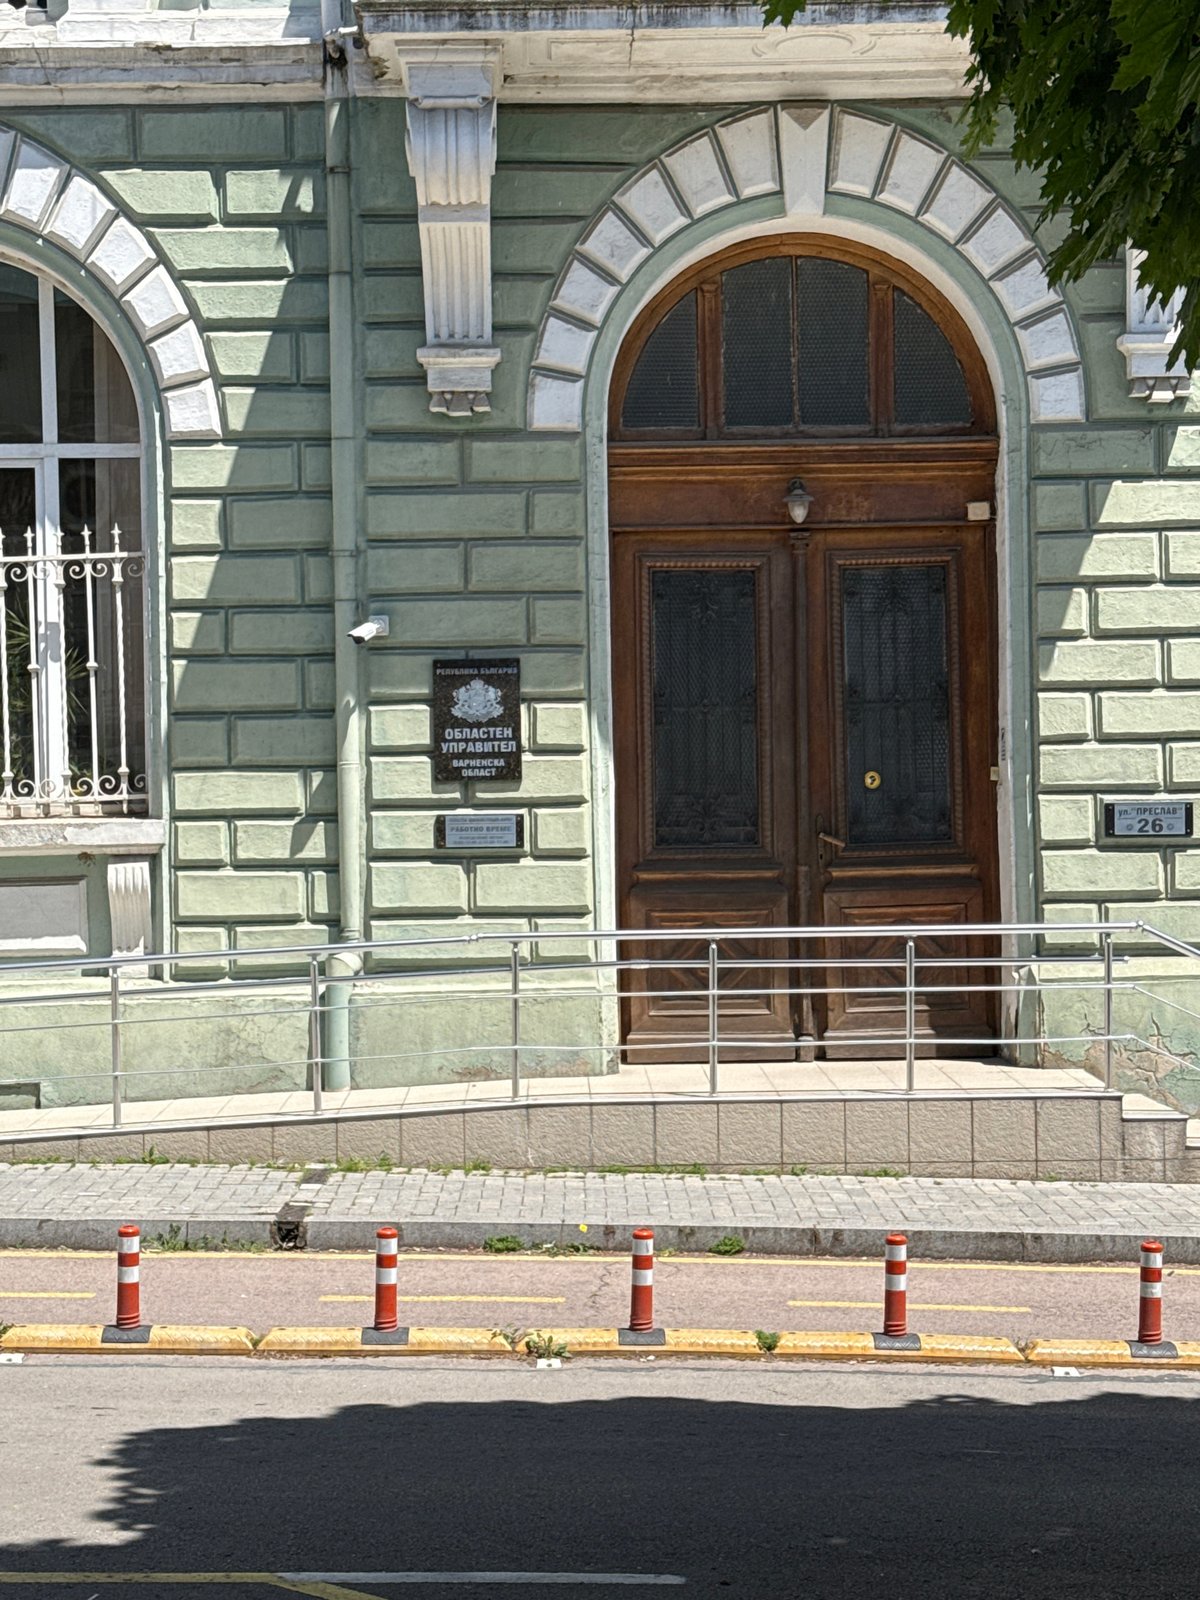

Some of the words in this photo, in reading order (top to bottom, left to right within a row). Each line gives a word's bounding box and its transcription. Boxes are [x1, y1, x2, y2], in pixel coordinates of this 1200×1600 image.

[445, 727, 513, 739] ОБЛАСТЕН
[441, 741, 517, 753] УПРАВИТЕЛ
[452, 759, 505, 767] ВАРНЕНСКА
[461, 768, 497, 777] ОБЛАСТ
[1137, 818, 1164, 833] 26
